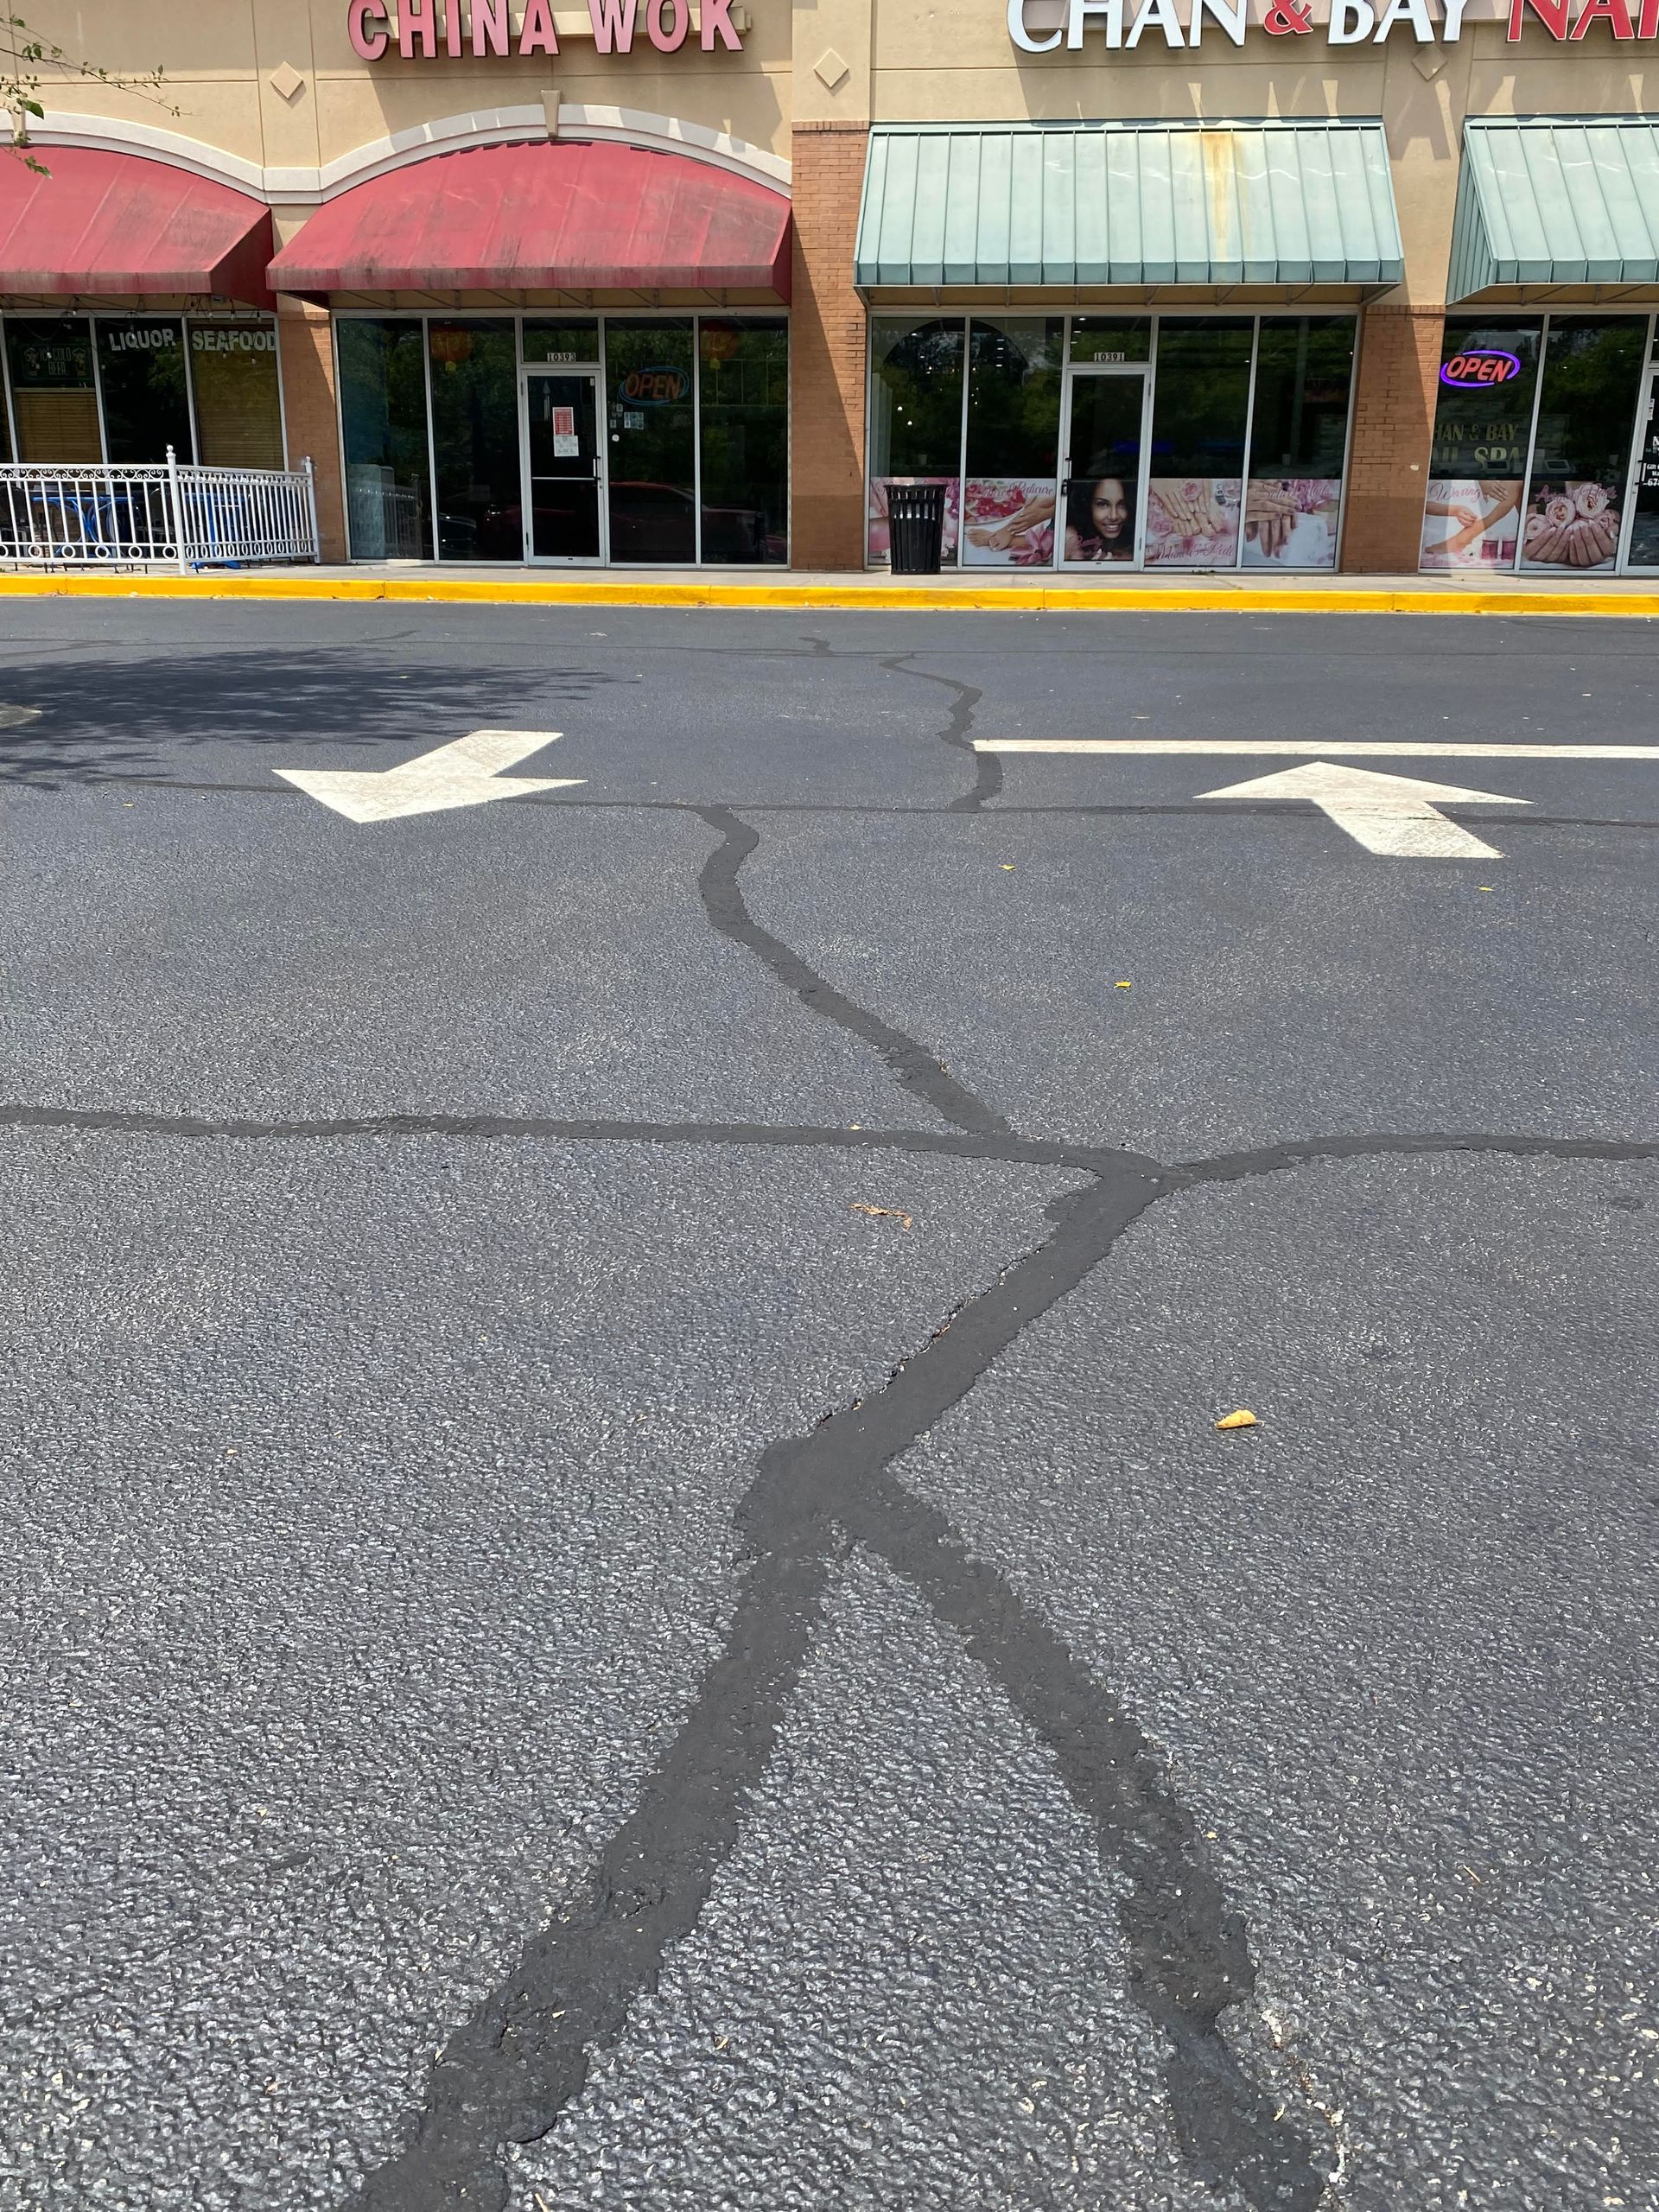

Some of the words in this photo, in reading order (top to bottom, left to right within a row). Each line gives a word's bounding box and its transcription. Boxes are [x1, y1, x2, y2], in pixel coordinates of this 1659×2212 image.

[347, 0, 560, 61] CHINA
[589, 0, 743, 54] WOK
[1007, 0, 1247, 54] CHAN
[1263, 0, 1313, 35] &
[1327, 0, 1468, 45] BAY
[109, 328, 175, 352] LIQUOR
[192, 330, 276, 352] SEAFOOD
[547, 353, 575, 361] 10393
[1095, 353, 1124, 361] 10391
[1446, 356, 1512, 382] OPEN
[625, 372, 682, 400] OPEN
[1486, 423, 1519, 441] BAY
